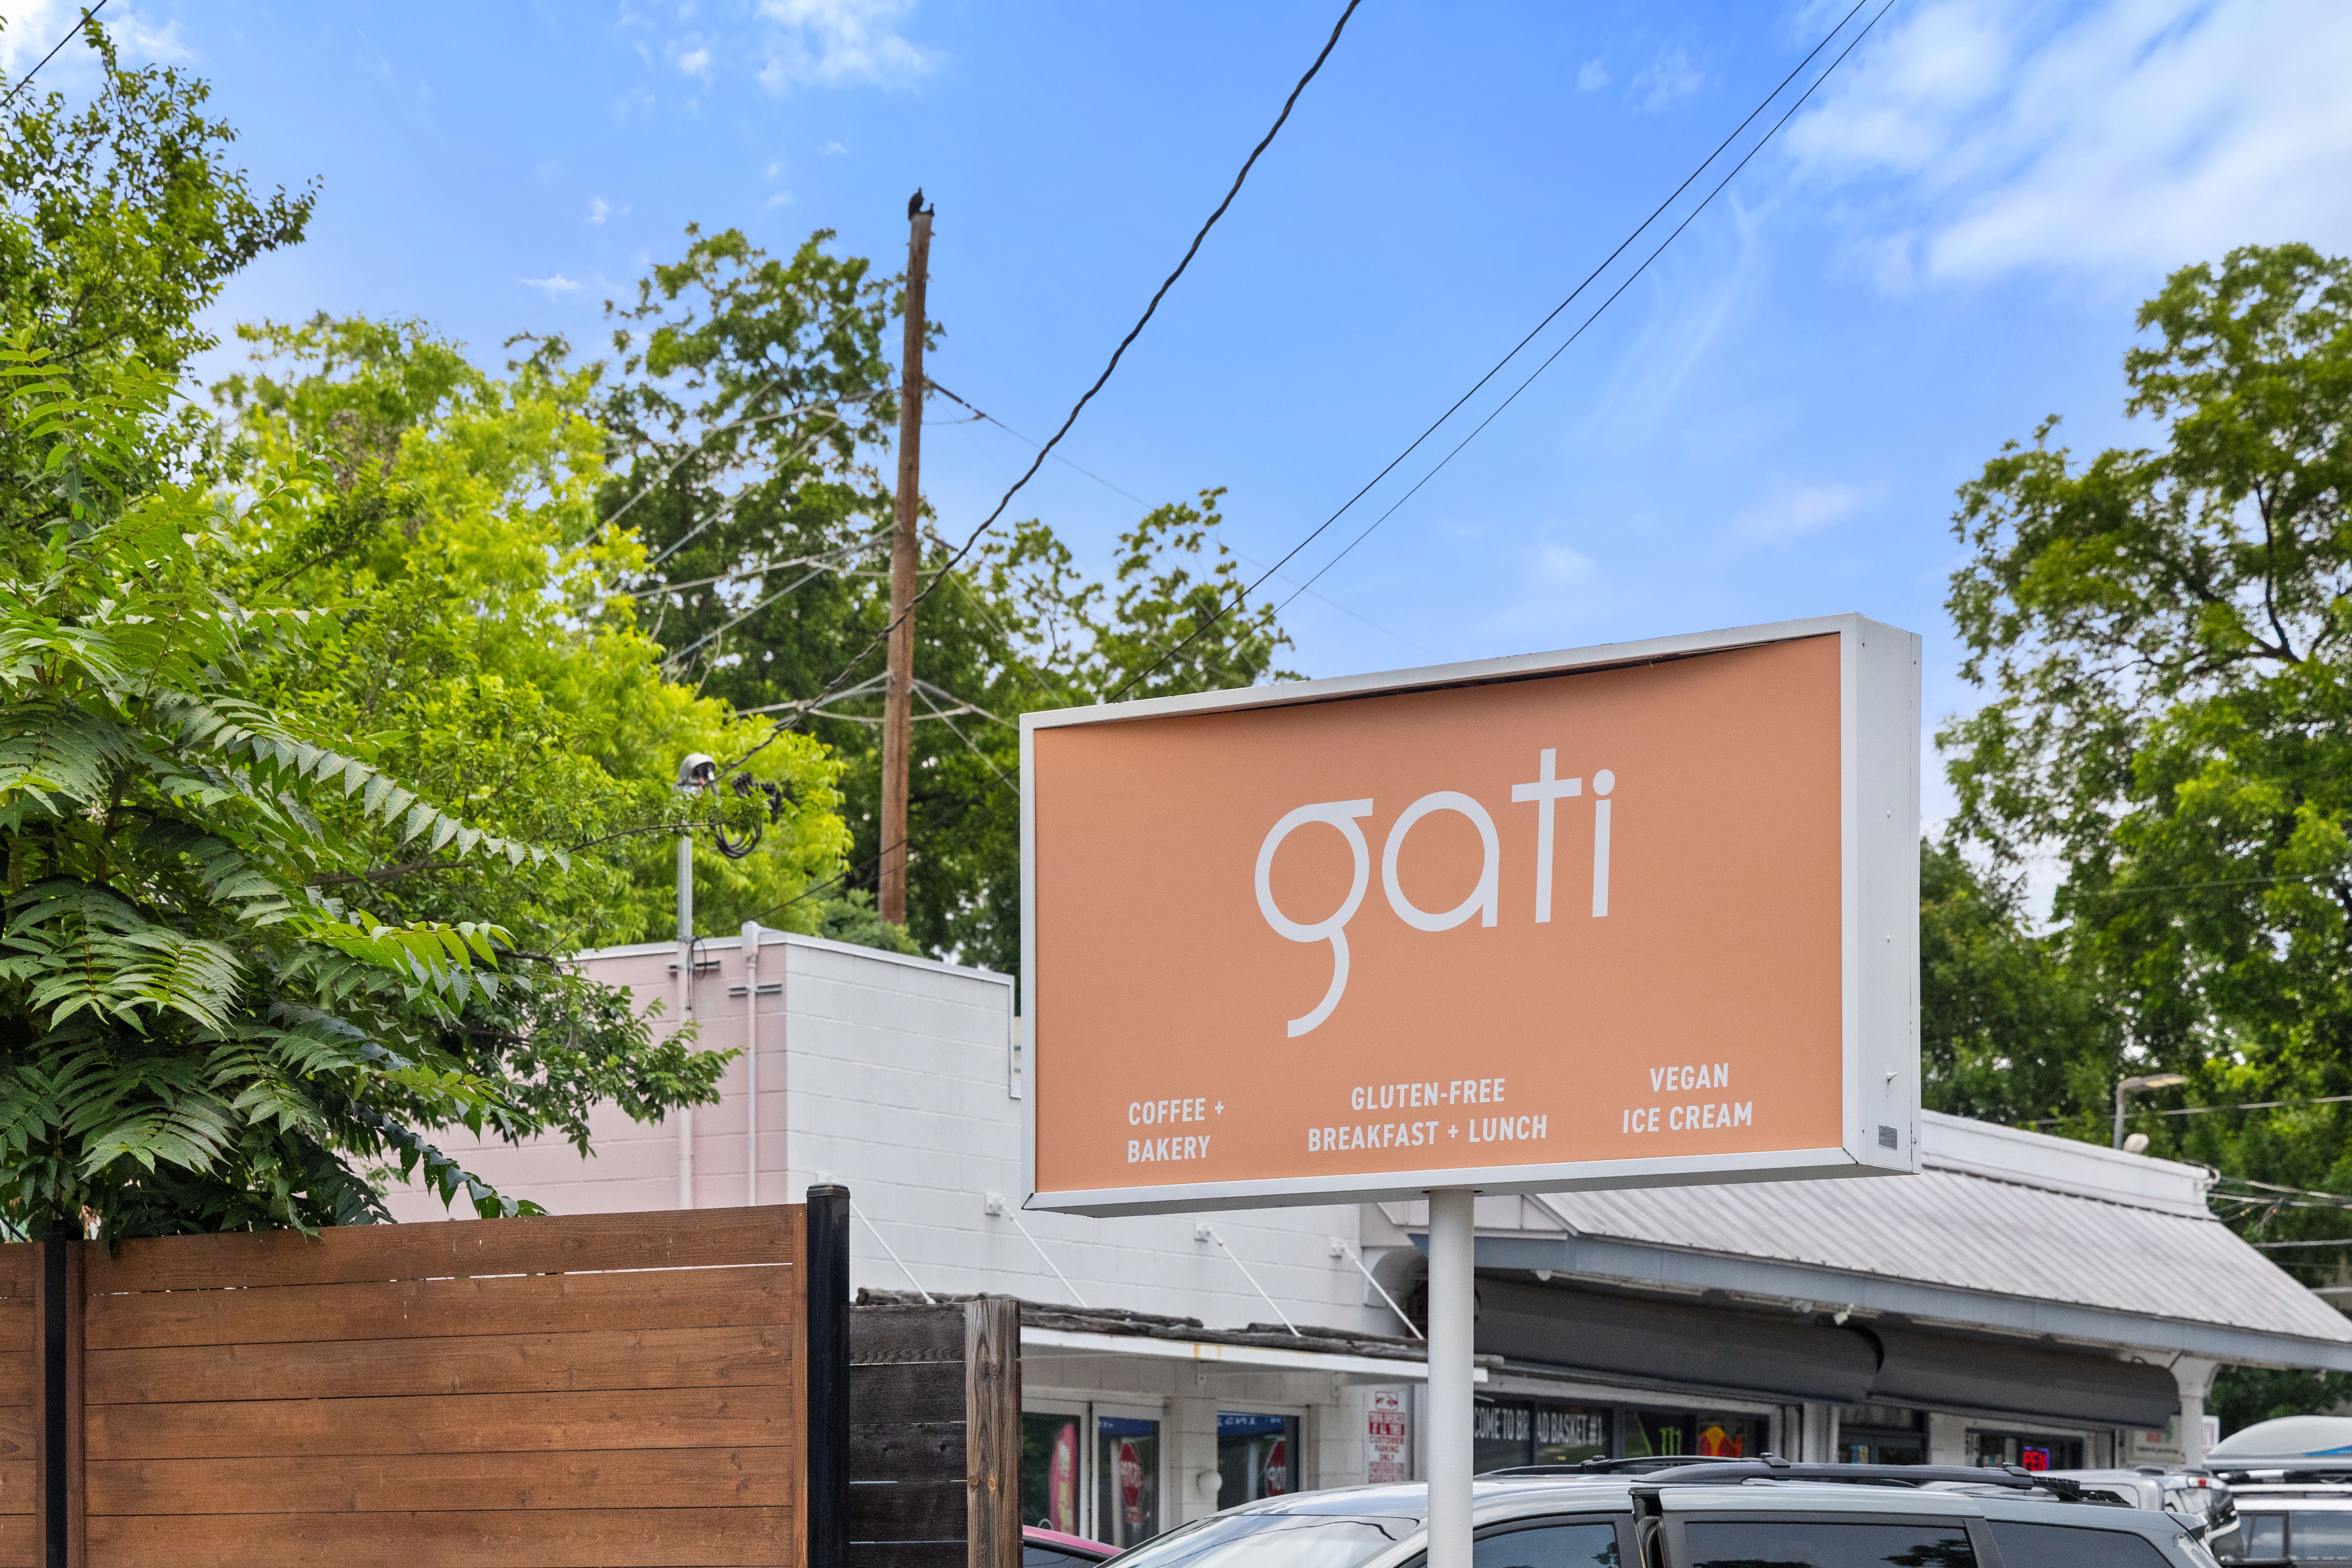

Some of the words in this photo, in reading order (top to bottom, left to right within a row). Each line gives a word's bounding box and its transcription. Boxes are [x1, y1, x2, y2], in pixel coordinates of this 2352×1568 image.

[1255, 748, 1615, 1038] gati
[1650, 1063, 1728, 1091] VEGAN
[1352, 1078, 1505, 1110] GLUTEN-FREE
[1129, 1098, 1205, 1125] COFFEE
[1214, 1101, 1224, 1114] +
[1623, 1108, 1660, 1133] ICE
[1670, 1102, 1752, 1130] CREAM
[1309, 1121, 1439, 1151] BREAKFAST
[1448, 1125, 1458, 1138] +
[1470, 1115, 1546, 1142] LUNCH
[1128, 1136, 1210, 1162] BAKERY
[1370, 1435, 1403, 1444] CUSTOMER
[1502, 1408, 1514, 1440] TO
[1516, 1409, 1548, 1443] BRAD
[1551, 1412, 1587, 1445] BASKET
